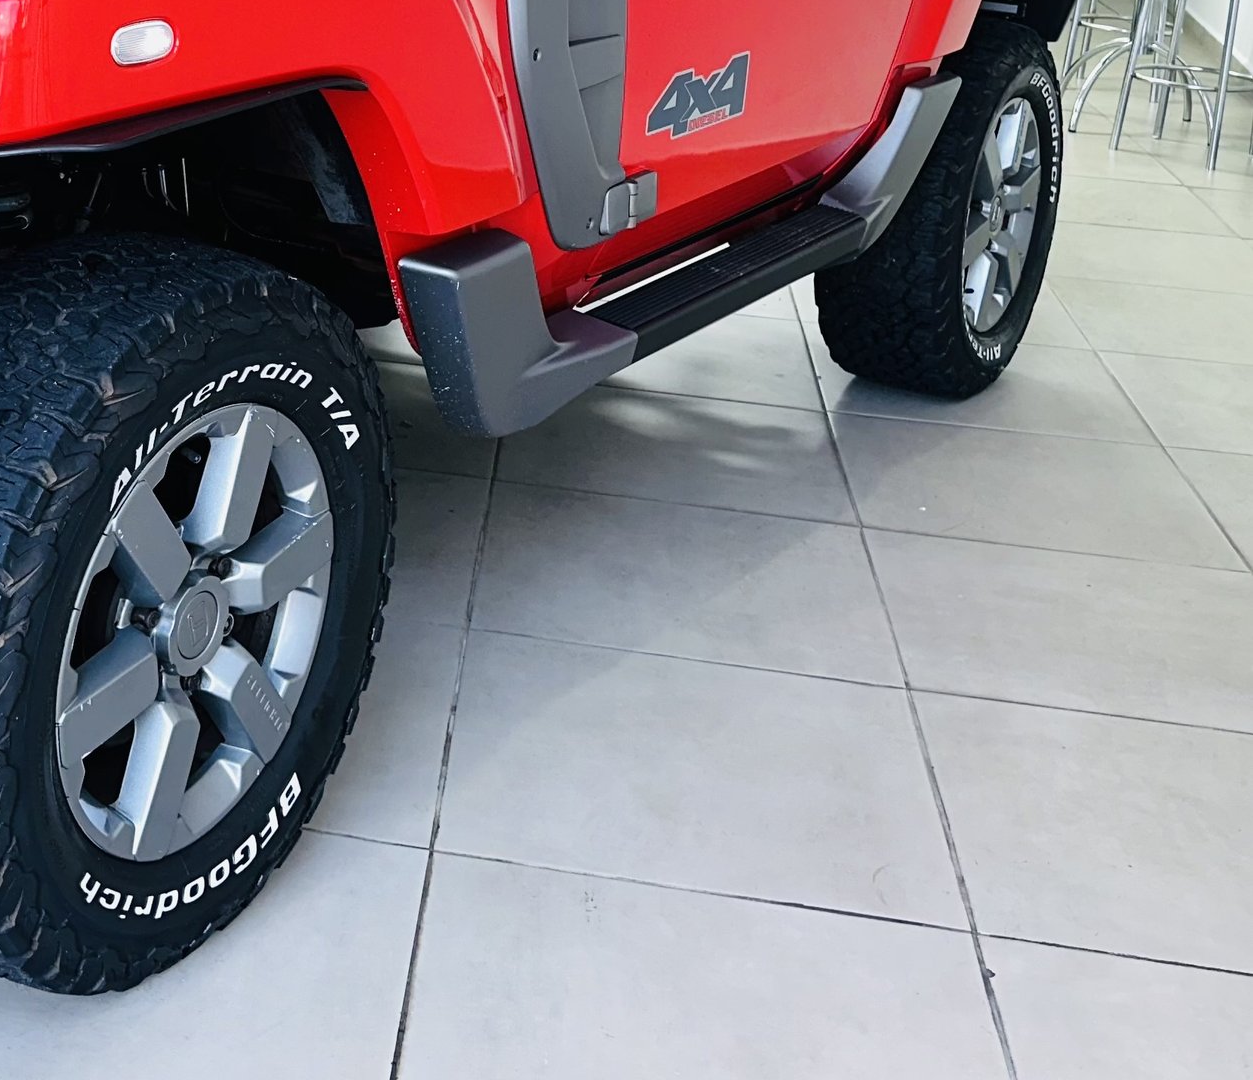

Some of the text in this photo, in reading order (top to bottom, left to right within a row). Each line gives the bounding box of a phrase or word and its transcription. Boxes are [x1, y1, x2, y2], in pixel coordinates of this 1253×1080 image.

[1029, 72, 1060, 204] BFGoodrich
[109, 361, 314, 512] All-Terrain
[79, 771, 302, 920] BFGoodrich
